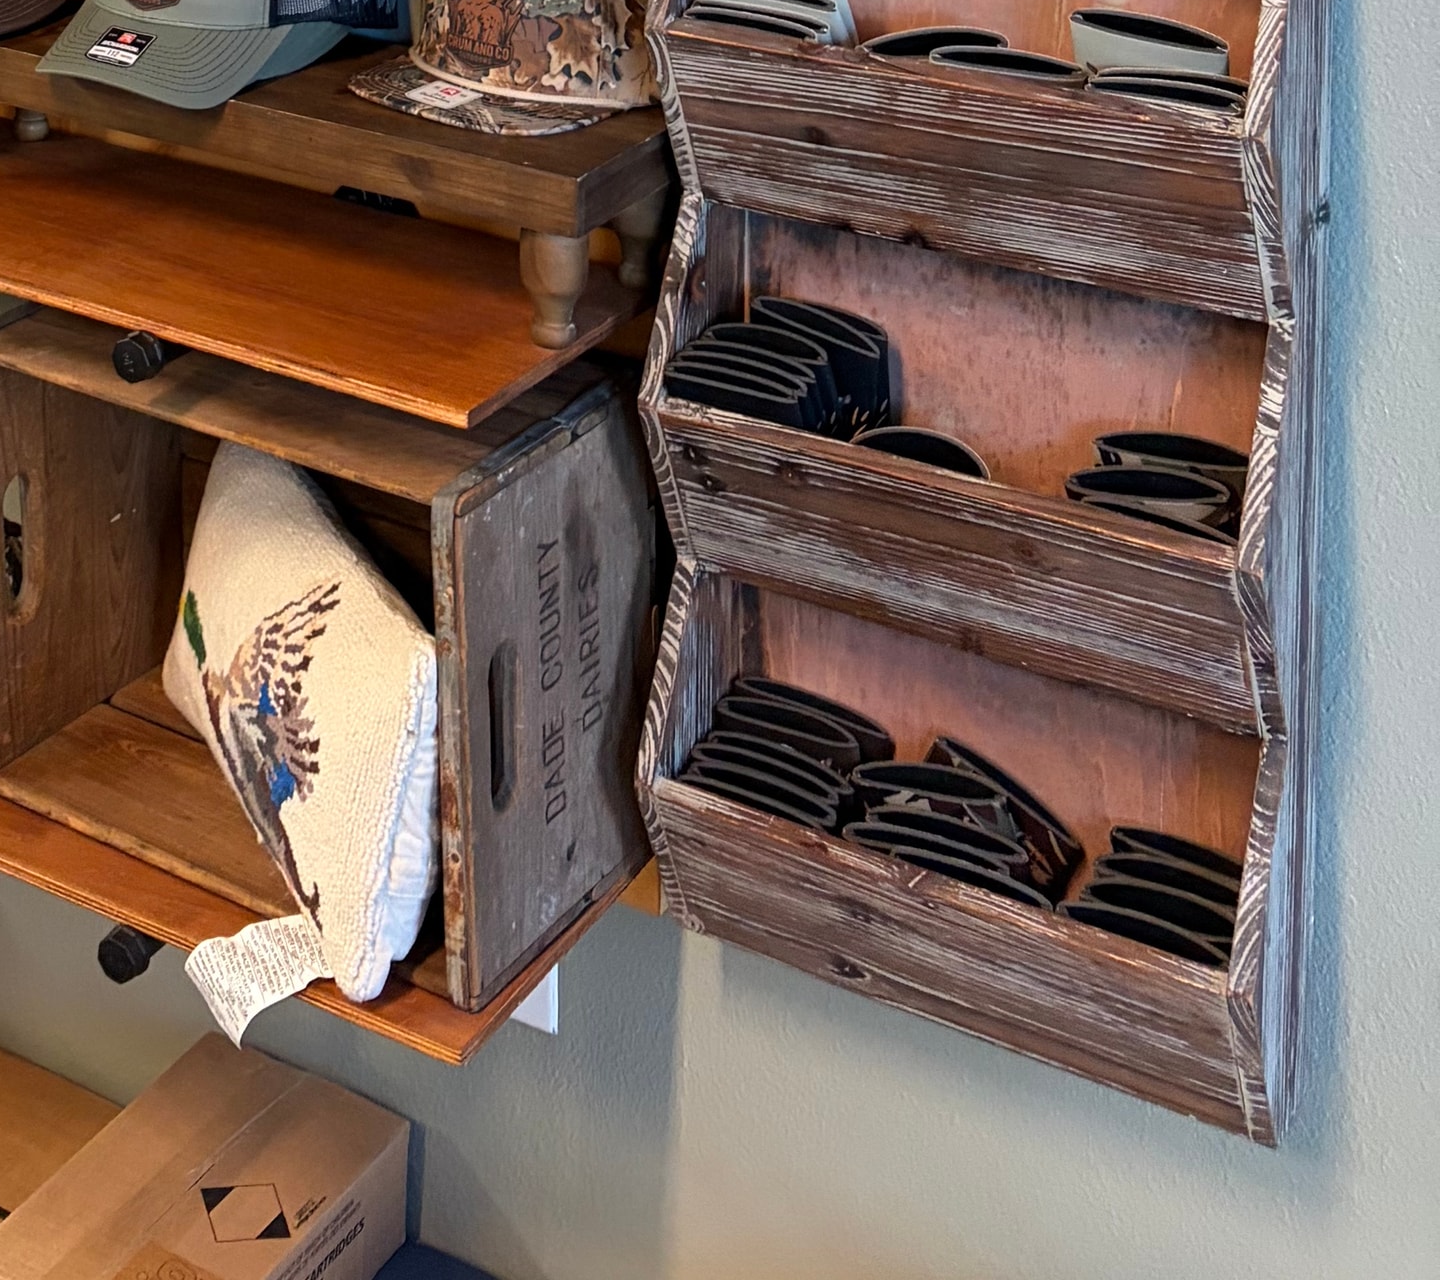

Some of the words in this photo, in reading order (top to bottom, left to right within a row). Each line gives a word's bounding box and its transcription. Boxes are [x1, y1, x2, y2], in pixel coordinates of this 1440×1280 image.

[475, 42, 494, 57] AND
[494, 46, 509, 60] CO
[536, 538, 564, 691] COUNTY
[578, 561, 604, 735] DAIRIES
[543, 712, 569, 826] DADE
